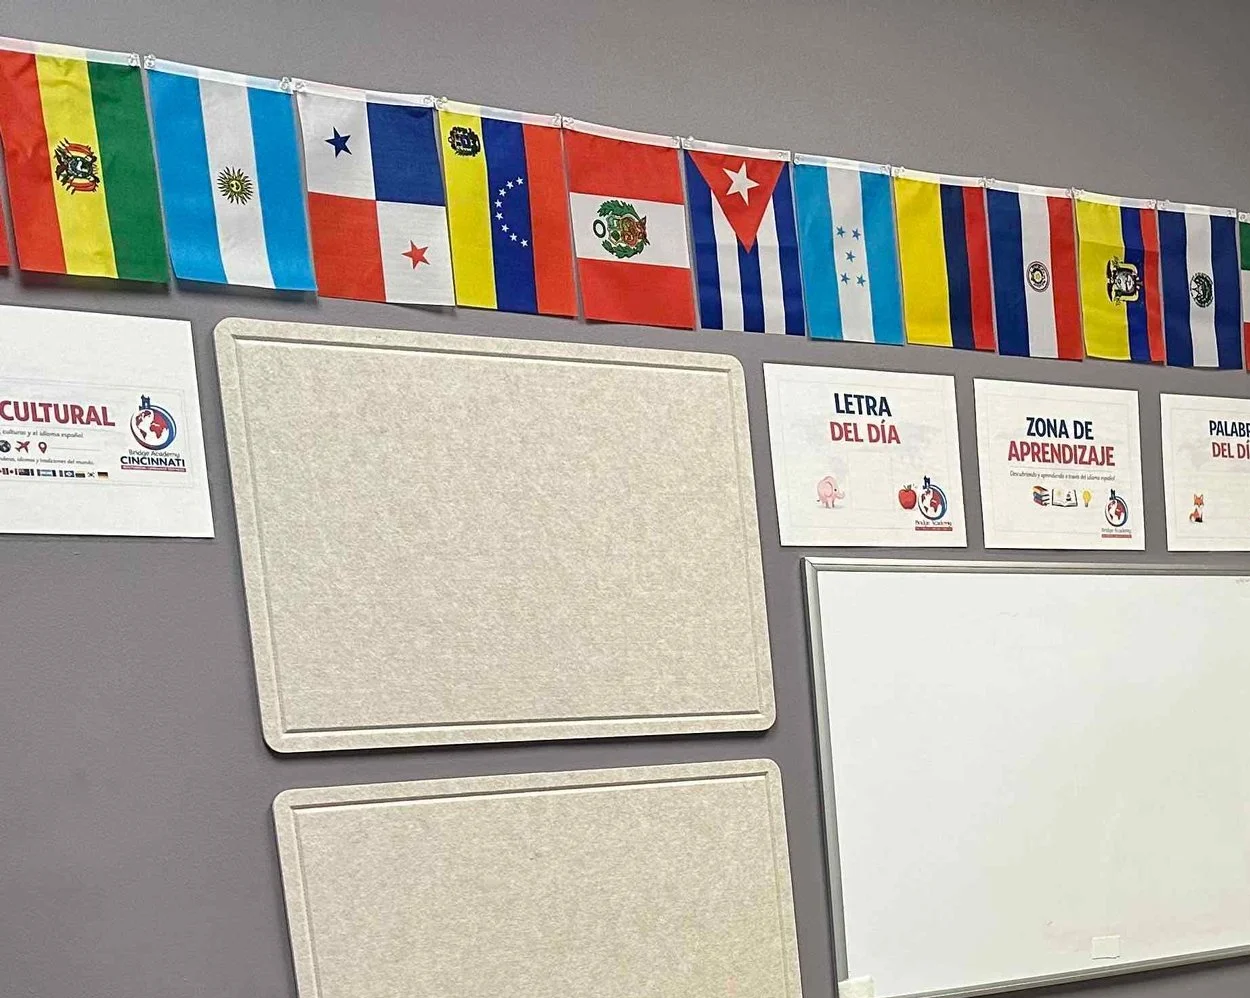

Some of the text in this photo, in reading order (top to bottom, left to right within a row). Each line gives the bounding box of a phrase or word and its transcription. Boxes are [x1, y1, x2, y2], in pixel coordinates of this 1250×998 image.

[0, 400, 116, 427] CULTURAL
[834, 392, 892, 417] LETRA
[830, 419, 901, 444] DEL DÍA
[1026, 416, 1094, 440] ZONA DE
[120, 456, 185, 467] CINCINNATI
[1008, 440, 1116, 466] APRENDIZAJE
[1212, 442, 1234, 459] DEL
